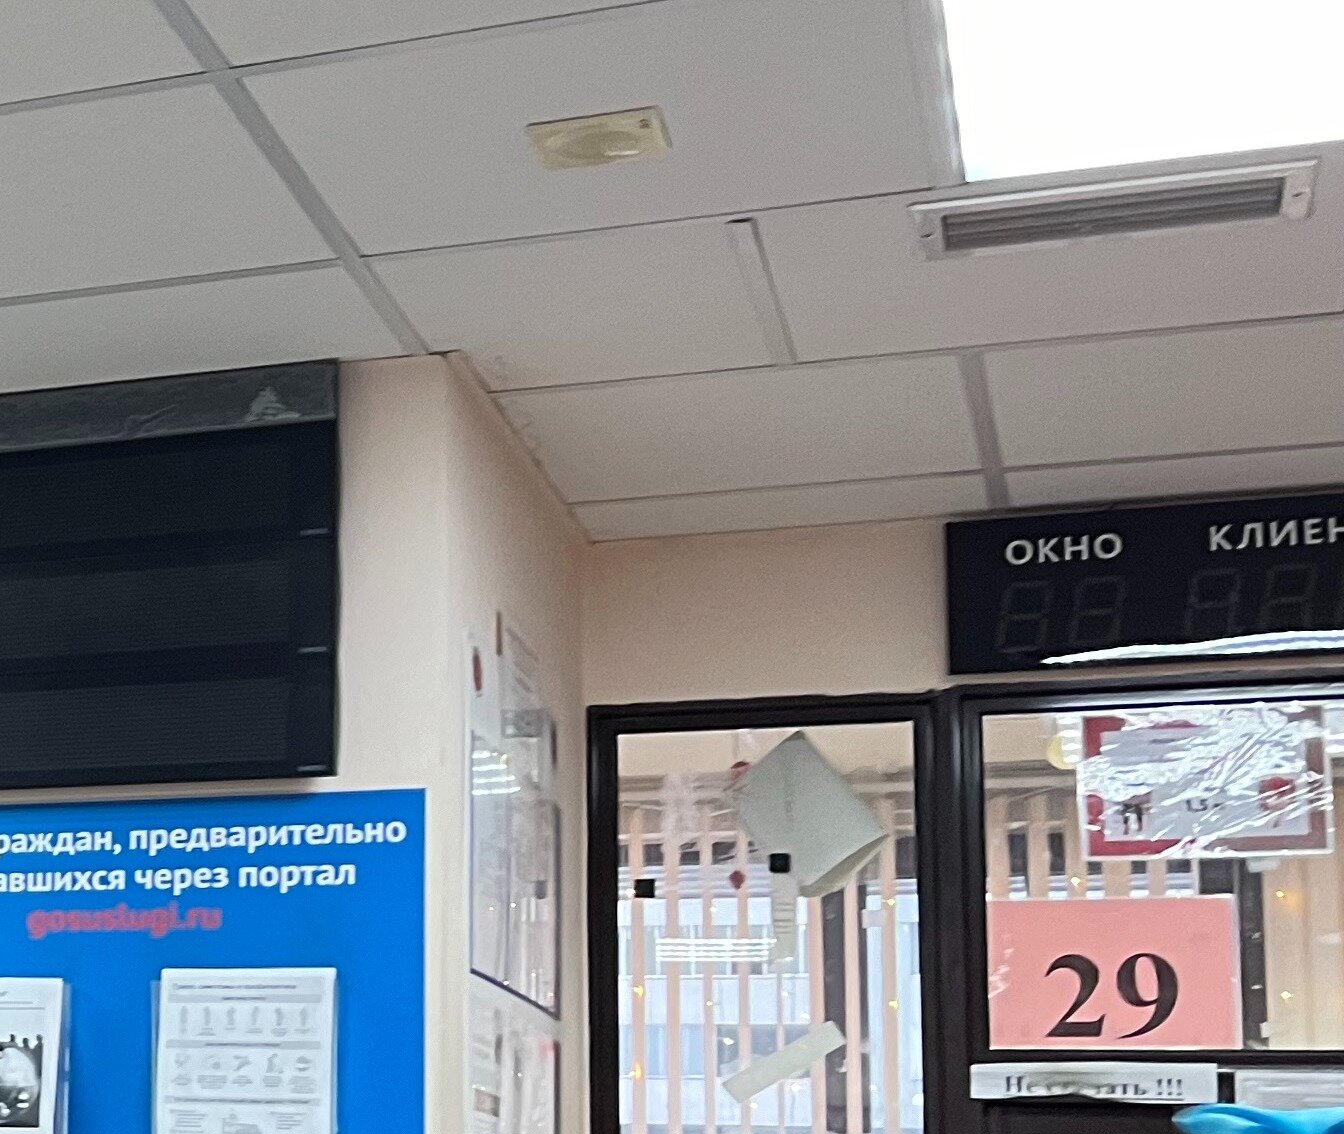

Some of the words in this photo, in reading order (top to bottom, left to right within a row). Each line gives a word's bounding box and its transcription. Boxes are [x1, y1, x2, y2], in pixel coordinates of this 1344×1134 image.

[1005, 533, 1124, 566] ОКНО
[1208, 517, 1344, 551] КЛИЕН
[128, 820, 408, 857] предварительно
[134, 867, 230, 896] через
[238, 863, 357, 894] портал
[26, 902, 223, 940] gosuslugi.ru
[1044, 953, 1179, 1039] 29
